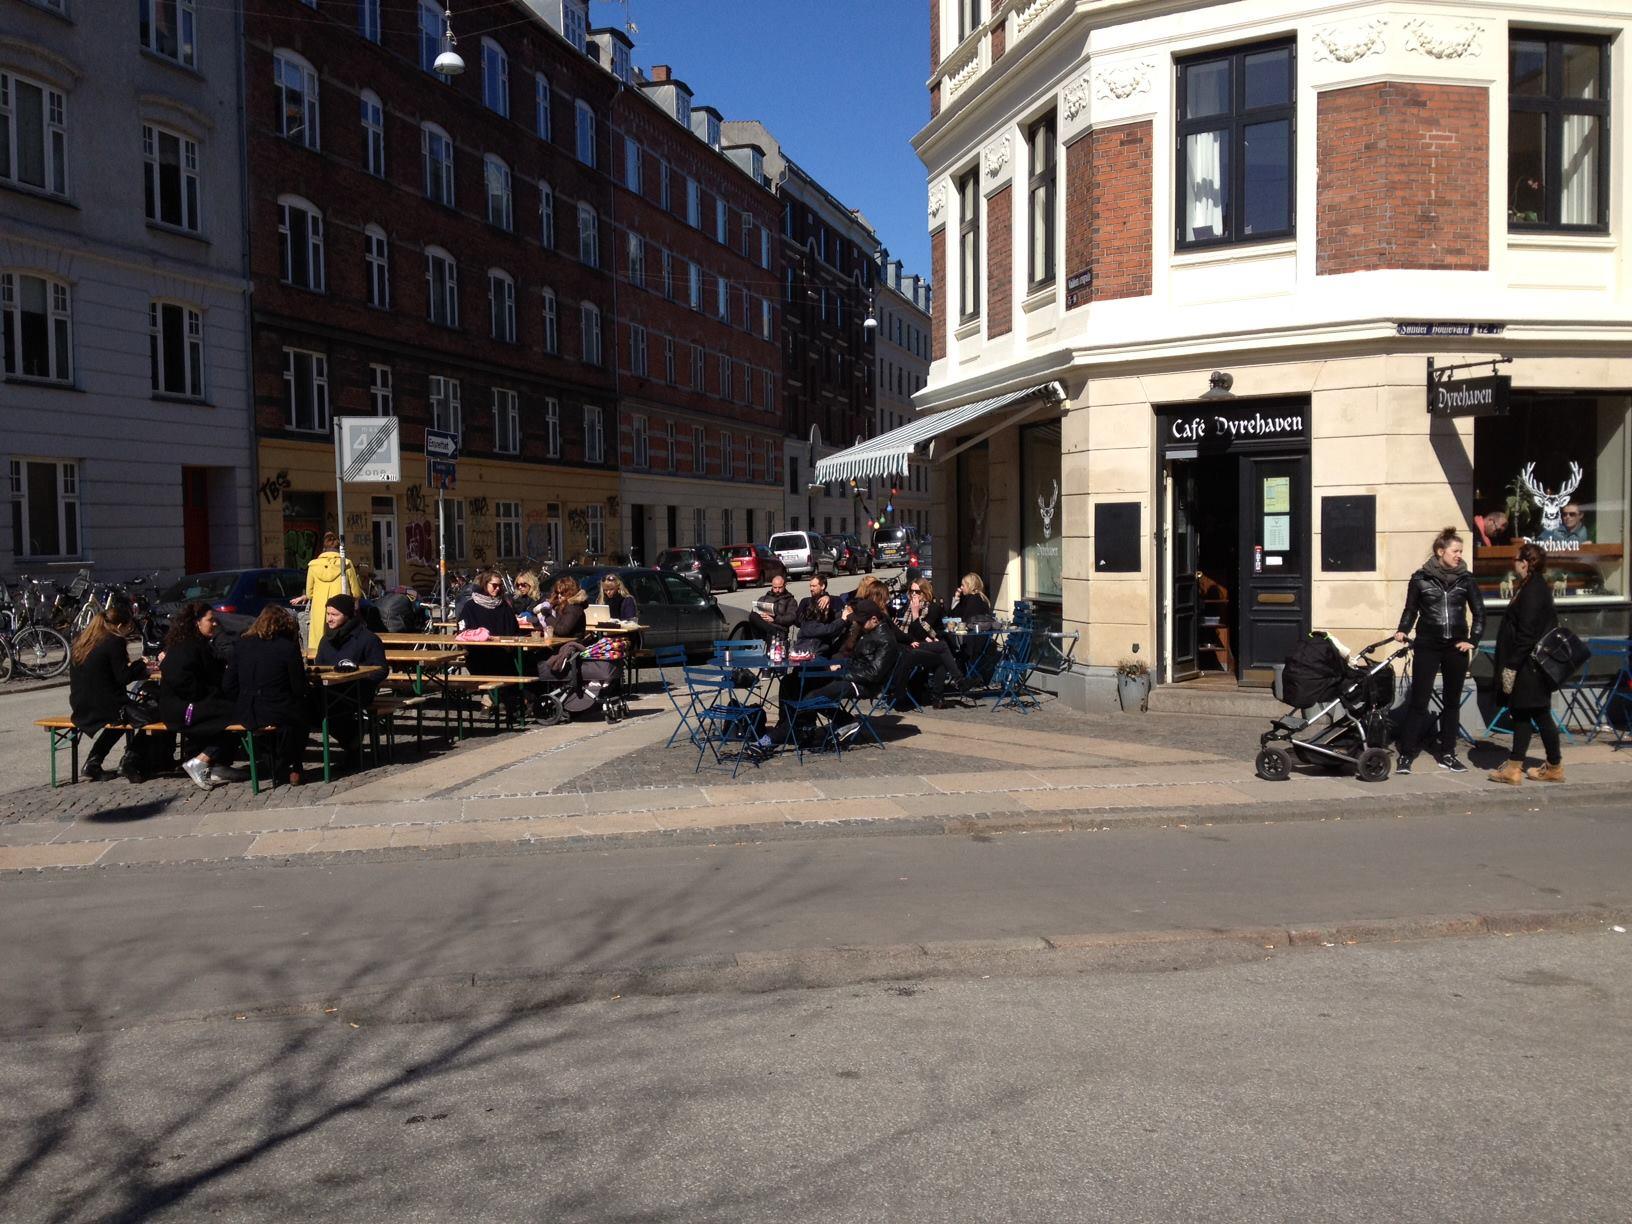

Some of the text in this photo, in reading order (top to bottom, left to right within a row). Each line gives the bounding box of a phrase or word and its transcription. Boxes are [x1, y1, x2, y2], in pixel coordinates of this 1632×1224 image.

[1438, 384, 1492, 413] Dyrehaven
[1172, 412, 1303, 440] Café Dyrehaven
